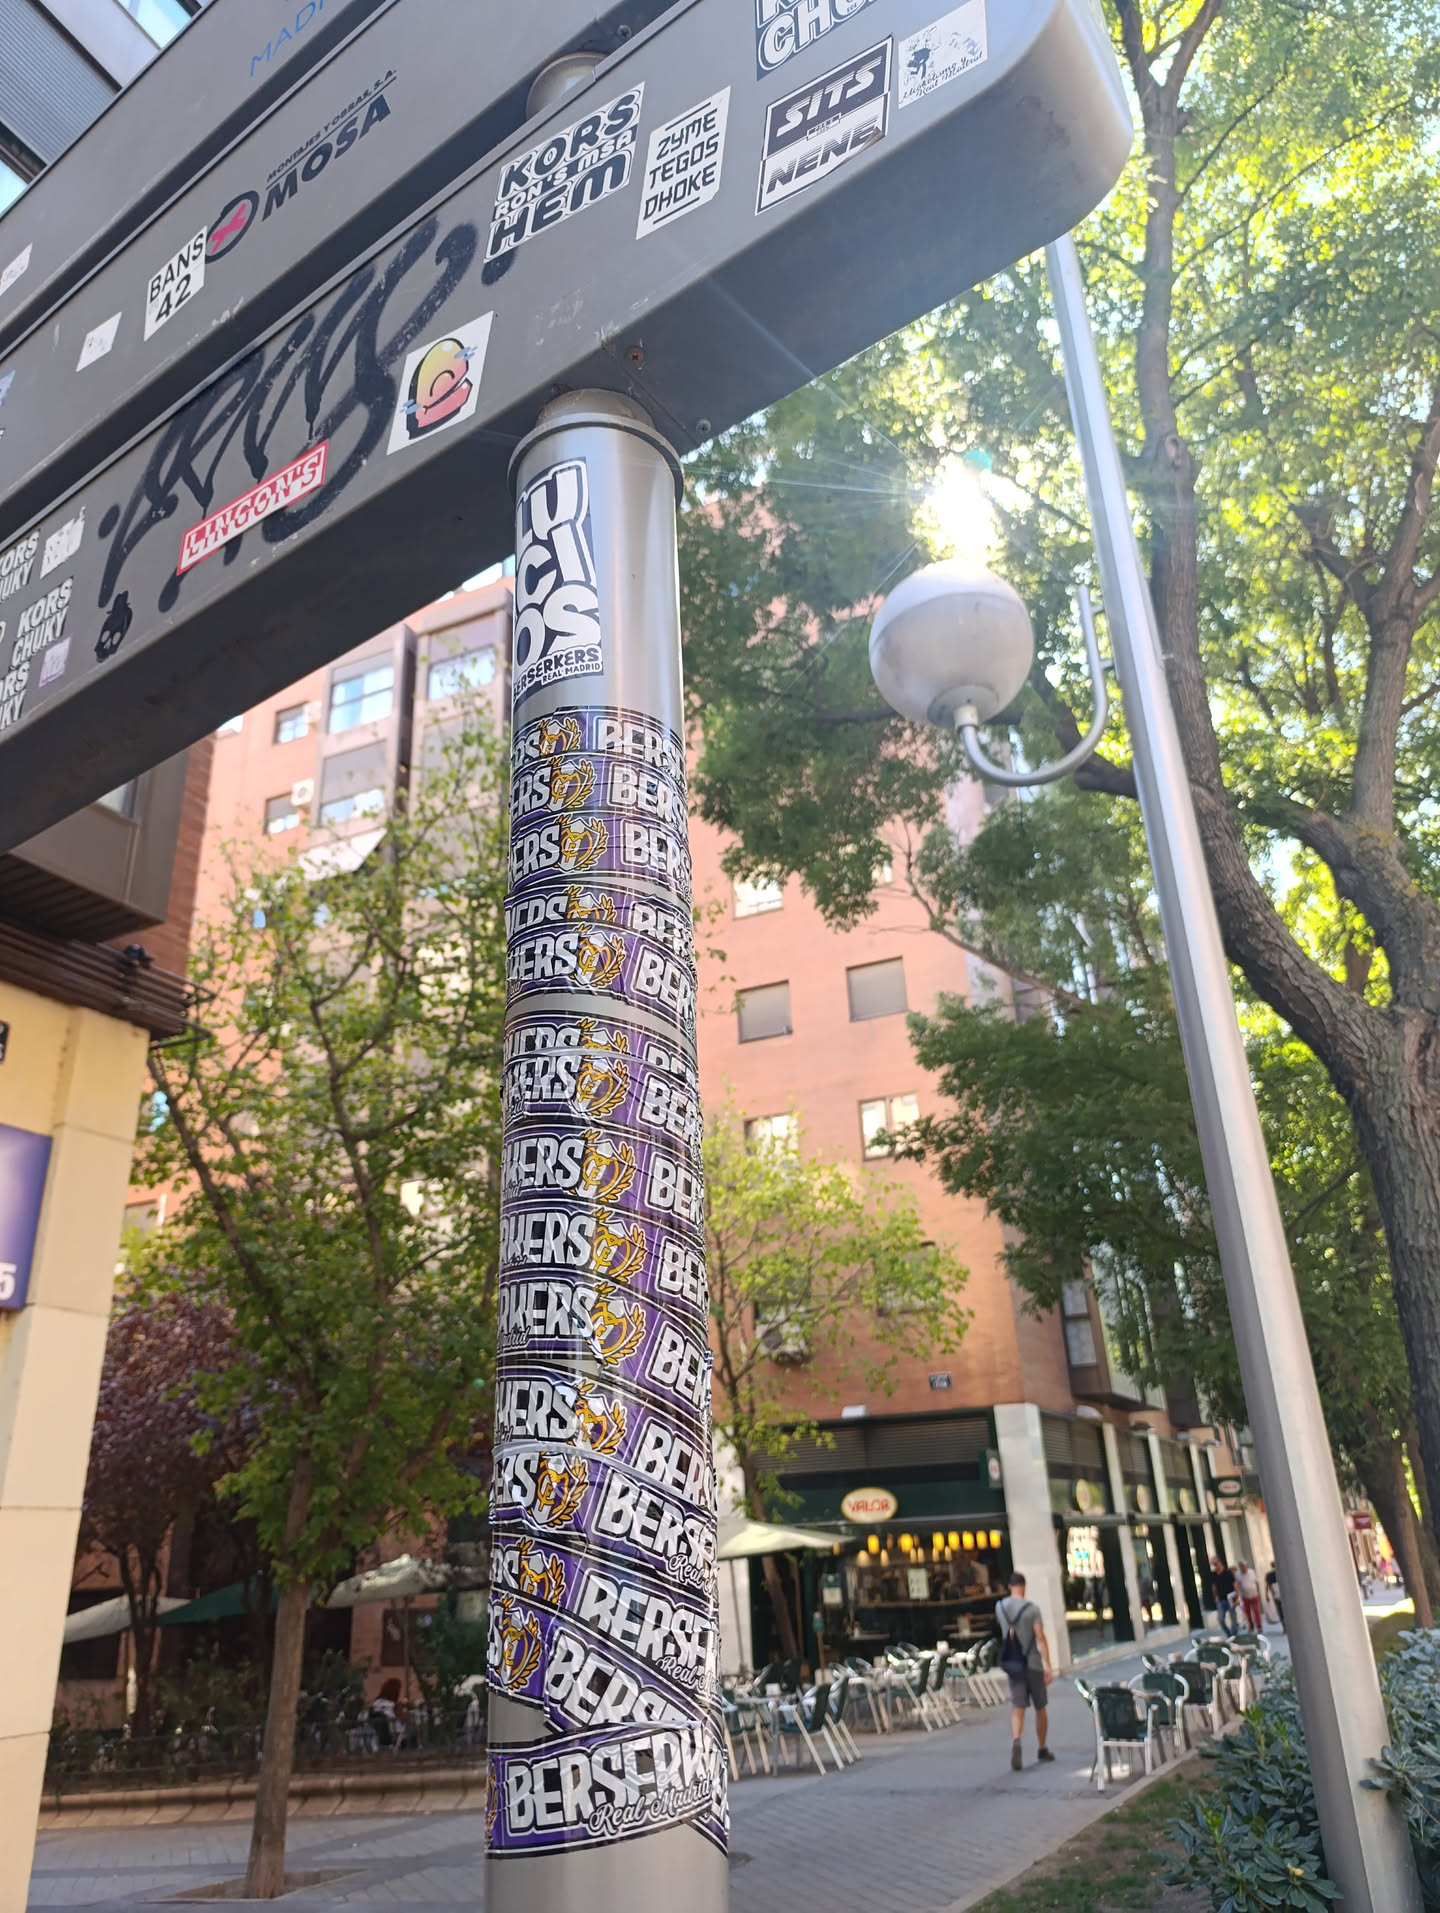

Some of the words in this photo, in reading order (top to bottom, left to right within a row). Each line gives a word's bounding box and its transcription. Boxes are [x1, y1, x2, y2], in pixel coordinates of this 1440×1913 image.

[776, 55, 883, 137] SITS
[262, 94, 391, 222] MOSA
[267, 131, 321, 183] MONTAJES
[499, 91, 640, 200] KORS
[649, 133, 720, 190] TEGOS
[656, 108, 718, 161] ZYME
[488, 152, 631, 257] HEM
[643, 162, 718, 220] DHOKE
[150, 233, 204, 303] BANS
[155, 273, 191, 322] 42
[17, 578, 73, 638] KORS
[542, 670, 563, 684] REAL
[565, 662, 601, 675] MADRID
[847, 1498, 890, 1512] VALOR
[590, 1798, 645, 1835] Real
[652, 1777, 712, 1818] Madrid
